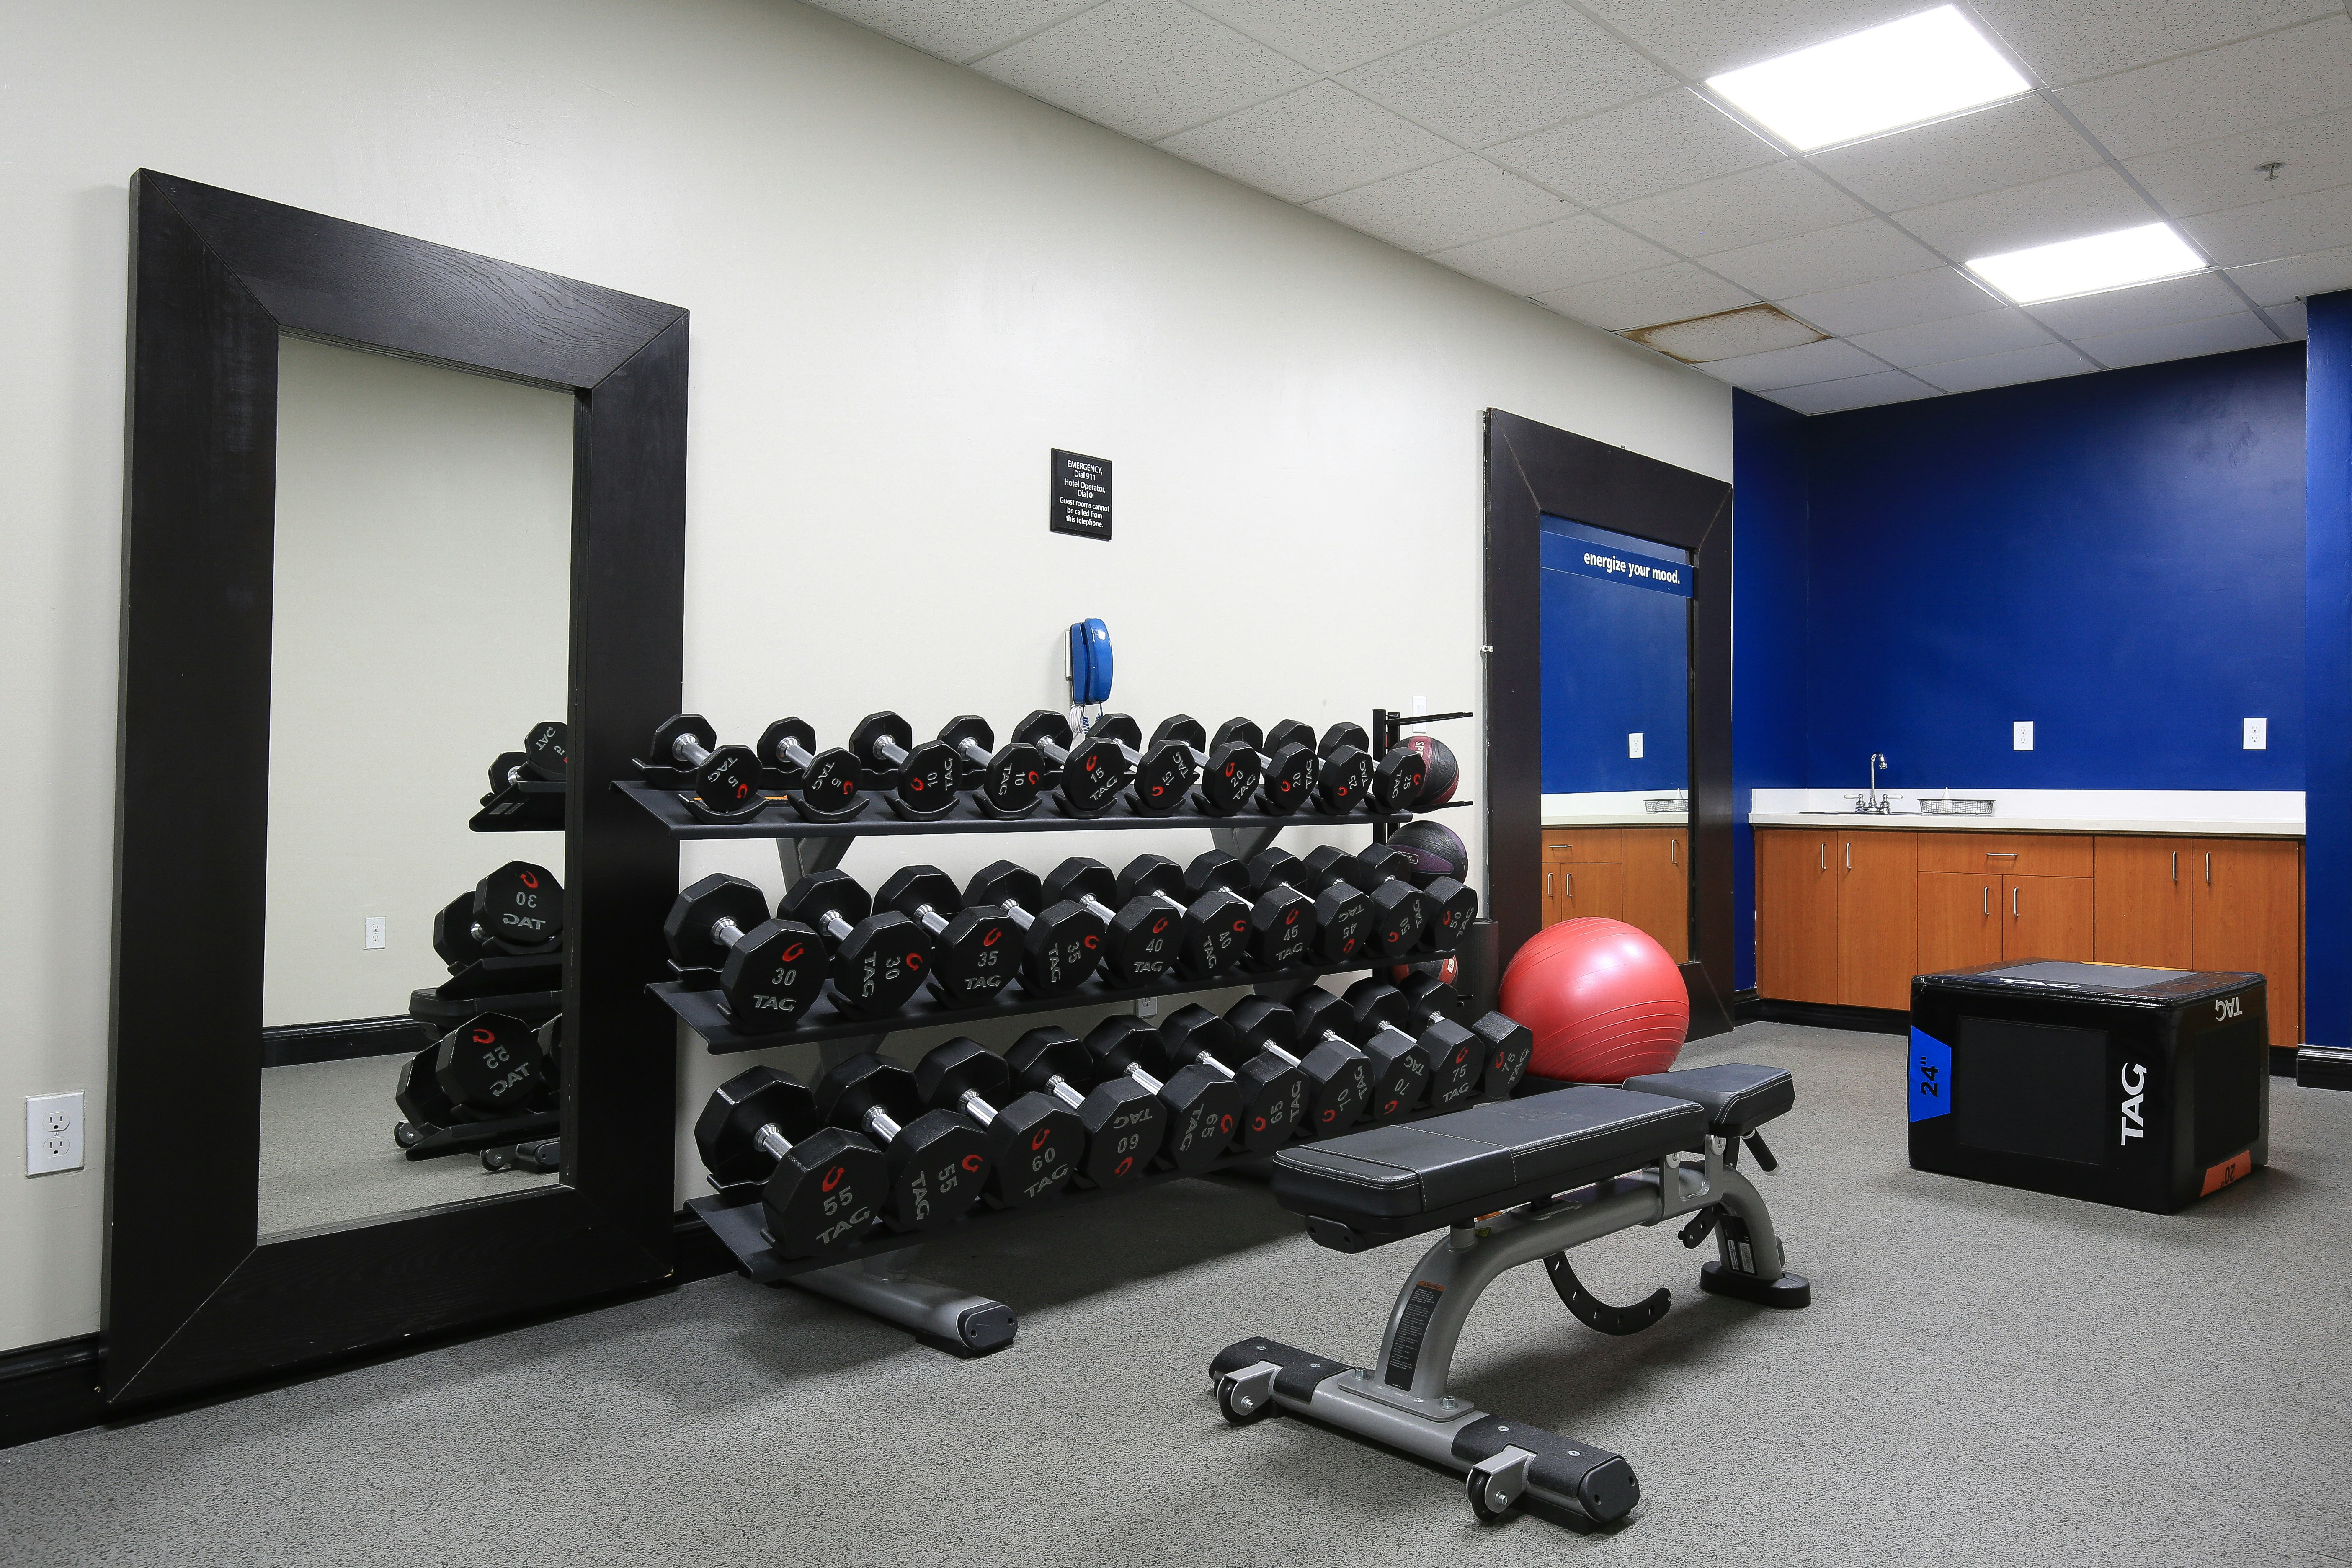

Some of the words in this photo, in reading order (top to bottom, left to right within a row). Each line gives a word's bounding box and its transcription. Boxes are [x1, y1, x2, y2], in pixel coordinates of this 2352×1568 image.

[1068, 460, 1103, 475] EMERGENCY,
[1074, 470, 1085, 479] Dial
[1086, 472, 1096, 481] 911
[1064, 478, 1079, 488] Hotel
[1080, 482, 1106, 494] Operator,
[1077, 489, 1088, 498] Dial
[1060, 497, 1075, 505] Guest
[1075, 500, 1091, 509] rooms
[1092, 504, 1110, 512] cannot
[1076, 517, 1103, 528] telephone.
[1583, 552, 1626, 573] energize
[1627, 562, 1650, 578] your
[1652, 568, 1680, 584] mood.
[708, 757, 738, 782] TAG
[1091, 767, 1104, 783] 15
[1173, 752, 1189, 779] TAG
[1360, 760, 1368, 787] TAG
[728, 776, 739, 787] 5
[812, 762, 835, 790] TAG
[831, 778, 842, 787] 5
[927, 772, 938, 787] 10
[998, 763, 1012, 795] TAG
[1015, 771, 1026, 786] 10
[1162, 771, 1174, 785] 15
[1231, 770, 1243, 787] 20
[1293, 772, 1301, 788] 20
[1348, 775, 1357, 790] 25
[1392, 769, 1403, 799] TAG
[1403, 775, 1412, 789] 25
[1090, 775, 1118, 801] TAG
[1233, 774, 1256, 800] TAG
[1338, 905, 1364, 922] TAG
[1413, 899, 1423, 929] TAG
[1449, 912, 1461, 928] 50
[1456, 907, 1474, 938] TAG
[1283, 925, 1298, 941] 45
[1343, 923, 1357, 939] 45
[1400, 917, 1410, 935] 50
[1145, 938, 1163, 952] 40
[1220, 931, 1232, 948] 40
[977, 950, 998, 967] 35
[1068, 941, 1081, 963] 35
[1203, 935, 1217, 969] TAG
[1276, 943, 1303, 961] TAG
[885, 956, 900, 980] 30
[1049, 943, 1061, 983] TAG
[1134, 961, 1163, 972] TAG
[772, 967, 796, 985] 30
[862, 951, 876, 997] TAG
[965, 975, 1001, 990] TAG
[1999, 978, 2082, 989] TAG
[753, 995, 796, 1012] TAG
[2215, 997, 2243, 1021] TAG
[1403, 1055, 1424, 1076] TAG
[1501, 1052, 1516, 1072] 75
[1507, 1048, 1529, 1084] TAG
[1354, 1065, 1367, 1100] TAG
[1453, 1064, 1467, 1082] 75
[1920, 1056, 1938, 1098] 24"
[1395, 1078, 1410, 1096] 70
[1443, 1083, 1470, 1102] TAG
[1290, 1081, 1302, 1122] TAG
[1338, 1089, 1351, 1112] 70
[2121, 1063, 2147, 1146] TAG
[1113, 1108, 1153, 1129] TAG
[1271, 1101, 1283, 1123] 65
[1180, 1104, 1204, 1151] TAG
[1202, 1114, 1218, 1138] 65
[1117, 1134, 1139, 1153] 60
[1032, 1147, 1055, 1171] 60
[938, 1164, 957, 1193] 55
[1024, 1163, 1068, 1197] TAG
[823, 1186, 853, 1216] 55
[912, 1171, 930, 1220] TAG
[816, 1206, 870, 1245] TAG
